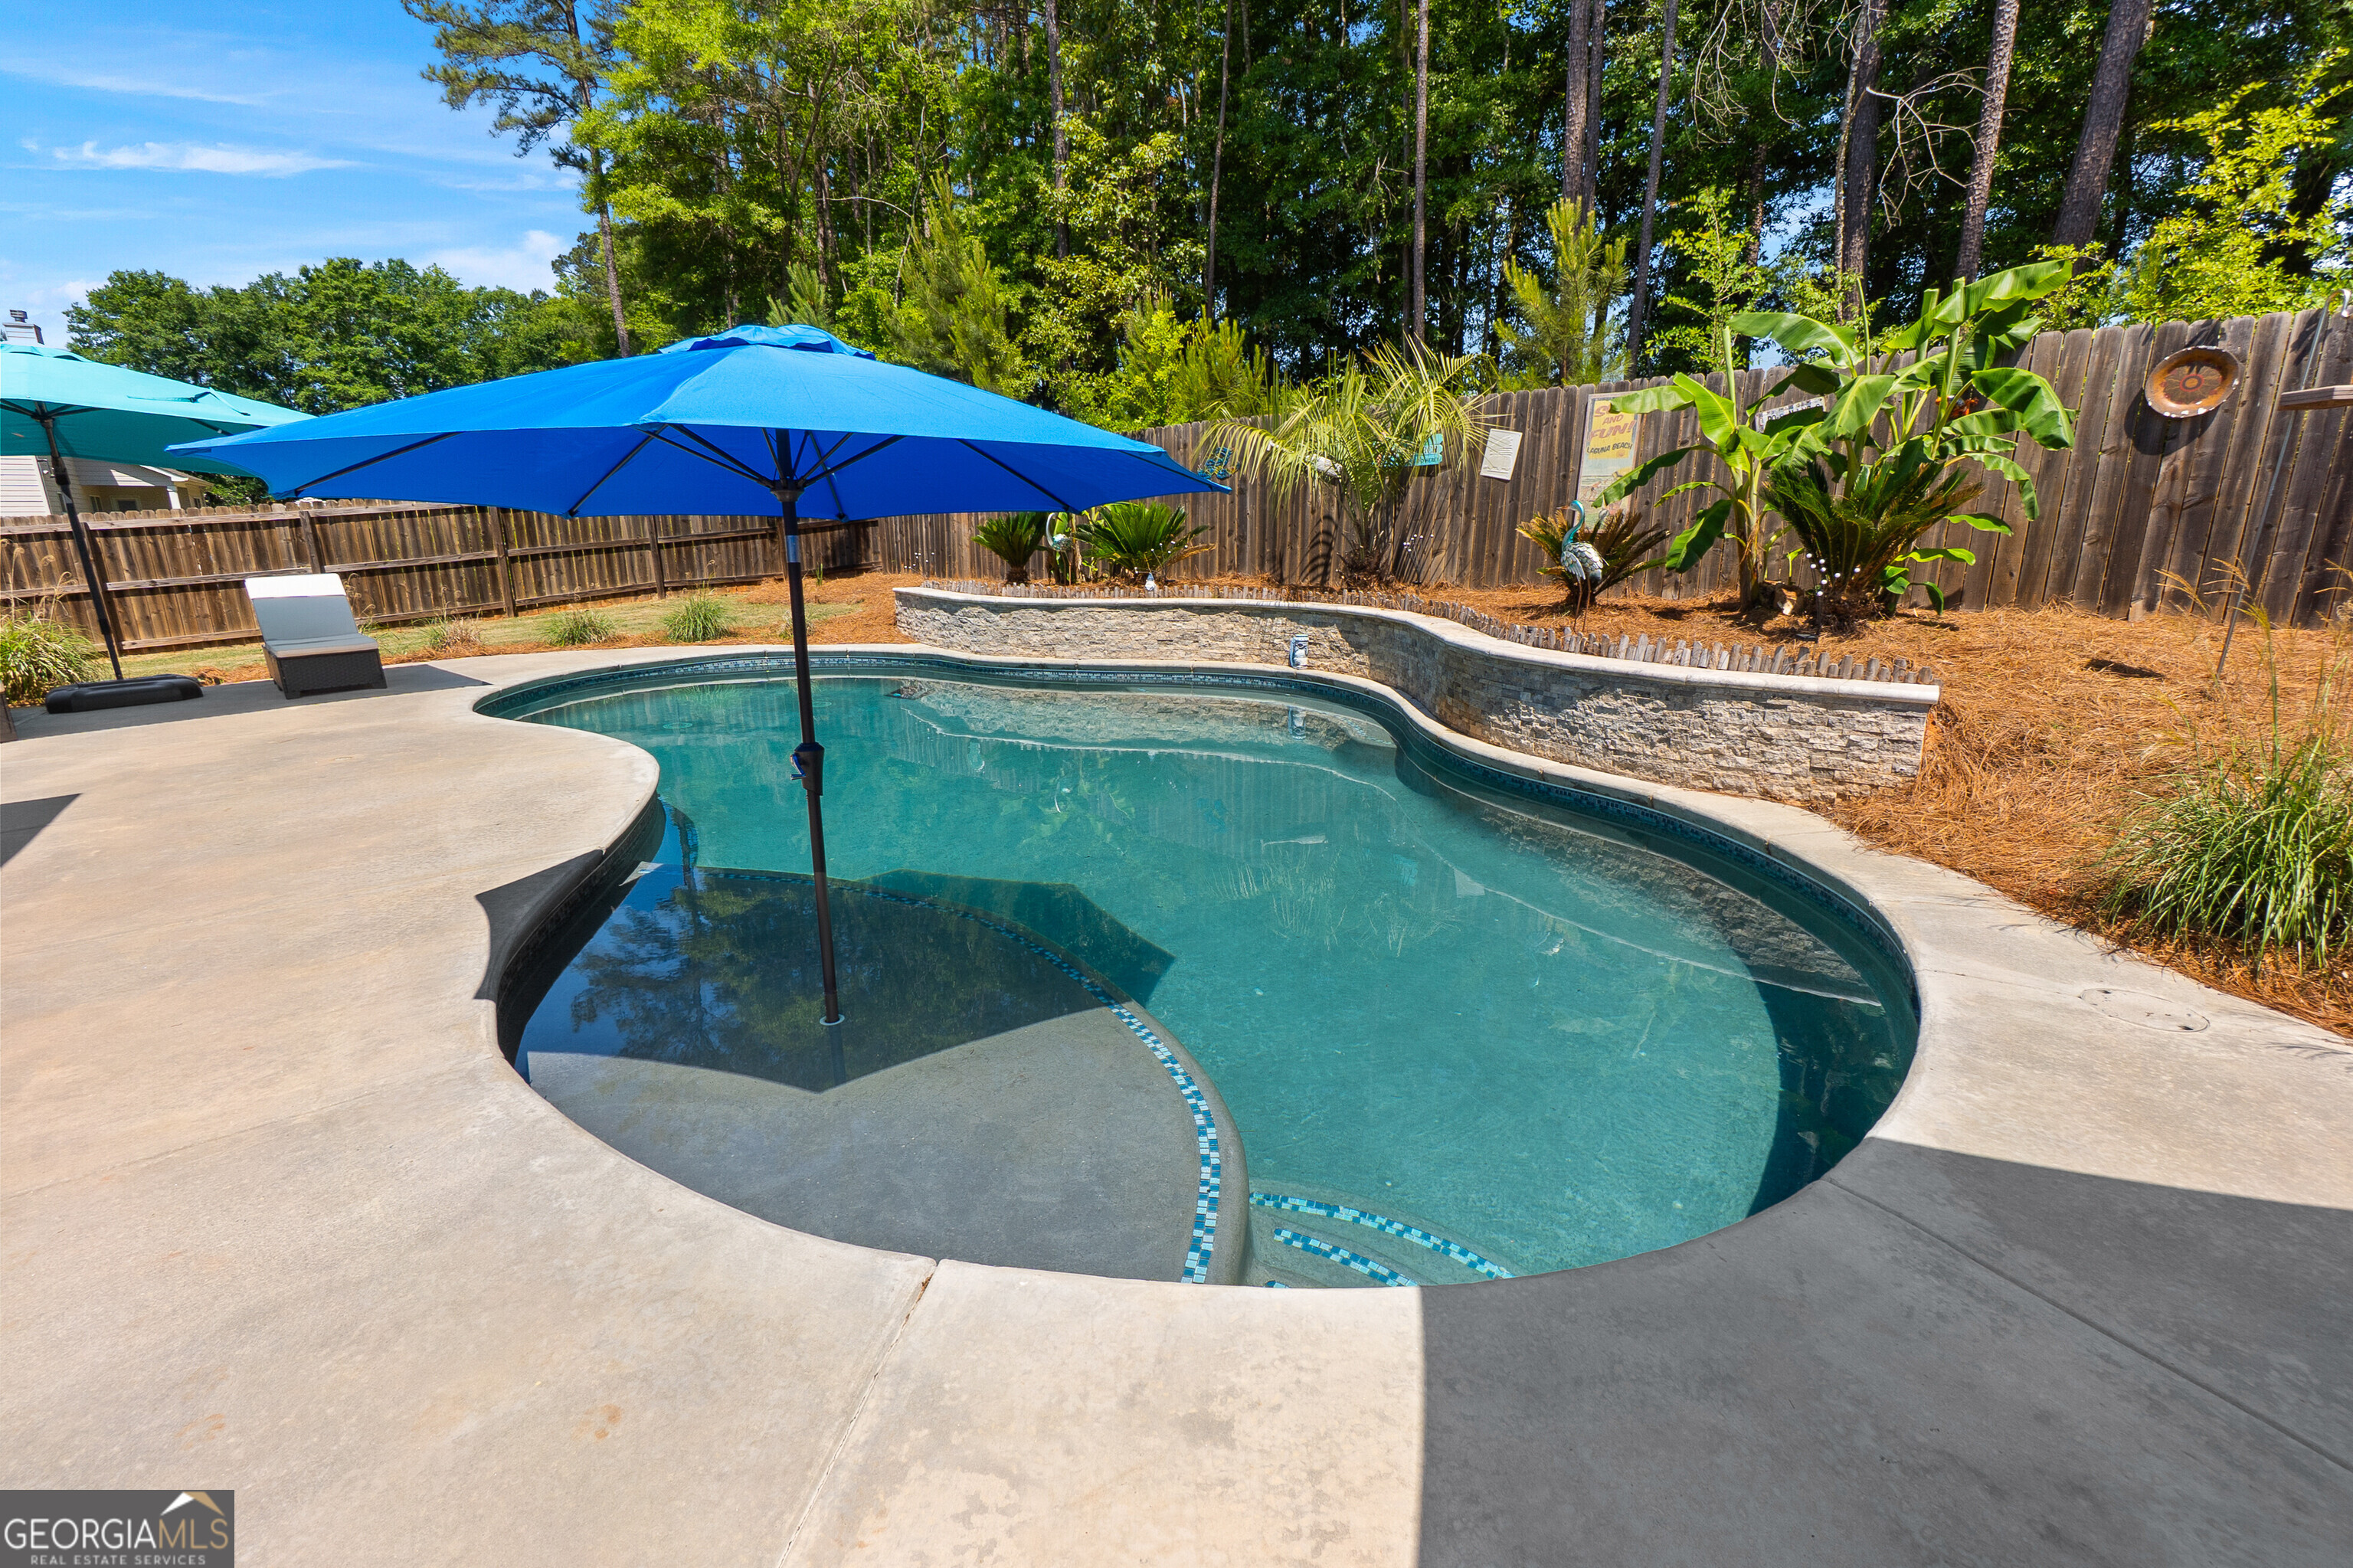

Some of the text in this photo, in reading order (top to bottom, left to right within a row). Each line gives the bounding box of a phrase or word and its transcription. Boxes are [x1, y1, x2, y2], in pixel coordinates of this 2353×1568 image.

[1602, 414, 1624, 425] AND
[1588, 420, 1637, 441] FUN!
[1586, 442, 1633, 454] LAGUNA BEACH
